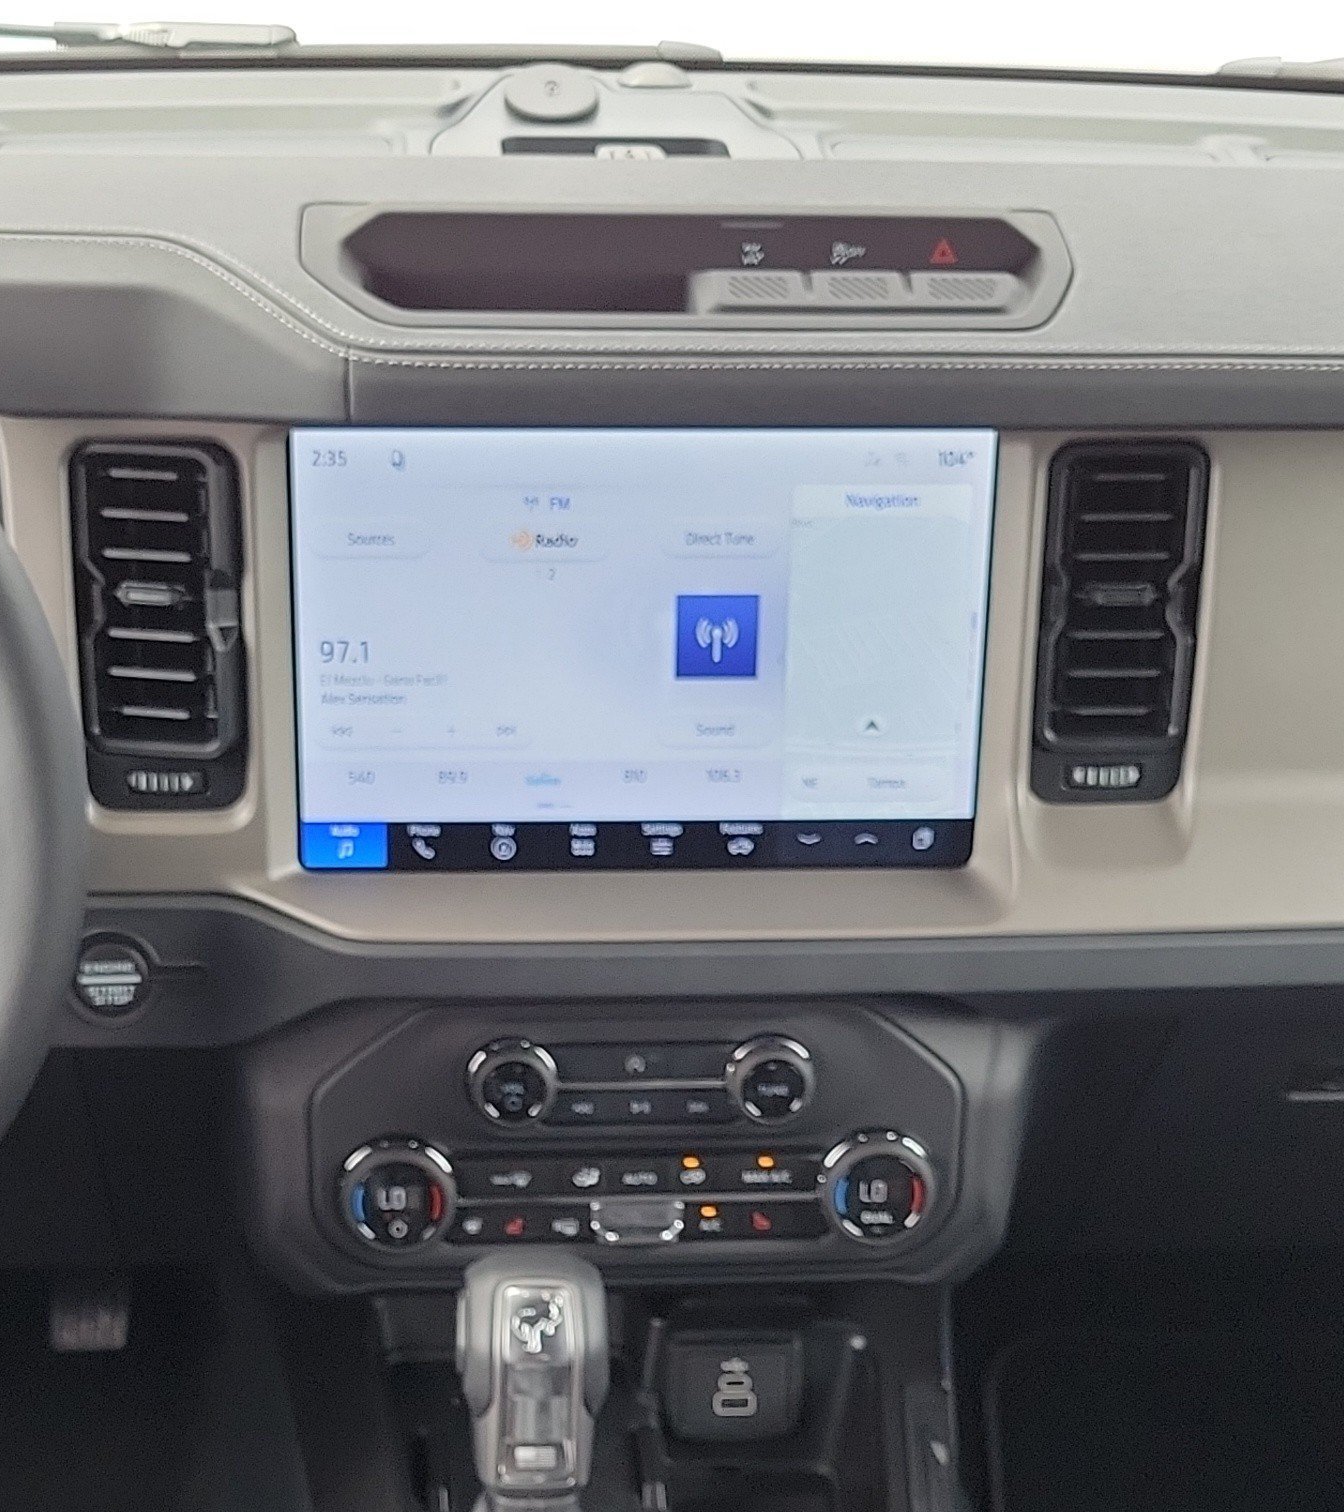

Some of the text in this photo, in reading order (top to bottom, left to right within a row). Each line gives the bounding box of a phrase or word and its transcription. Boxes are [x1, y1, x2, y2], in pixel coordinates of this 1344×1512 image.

[312, 450, 347, 467] 2:35
[845, 493, 919, 509] Navigation
[347, 532, 395, 546] Sources
[535, 533, 578, 548] Radio
[685, 532, 756, 546] Direct Tune
[319, 641, 370, 663] 97.1
[696, 723, 735, 737] Sound
